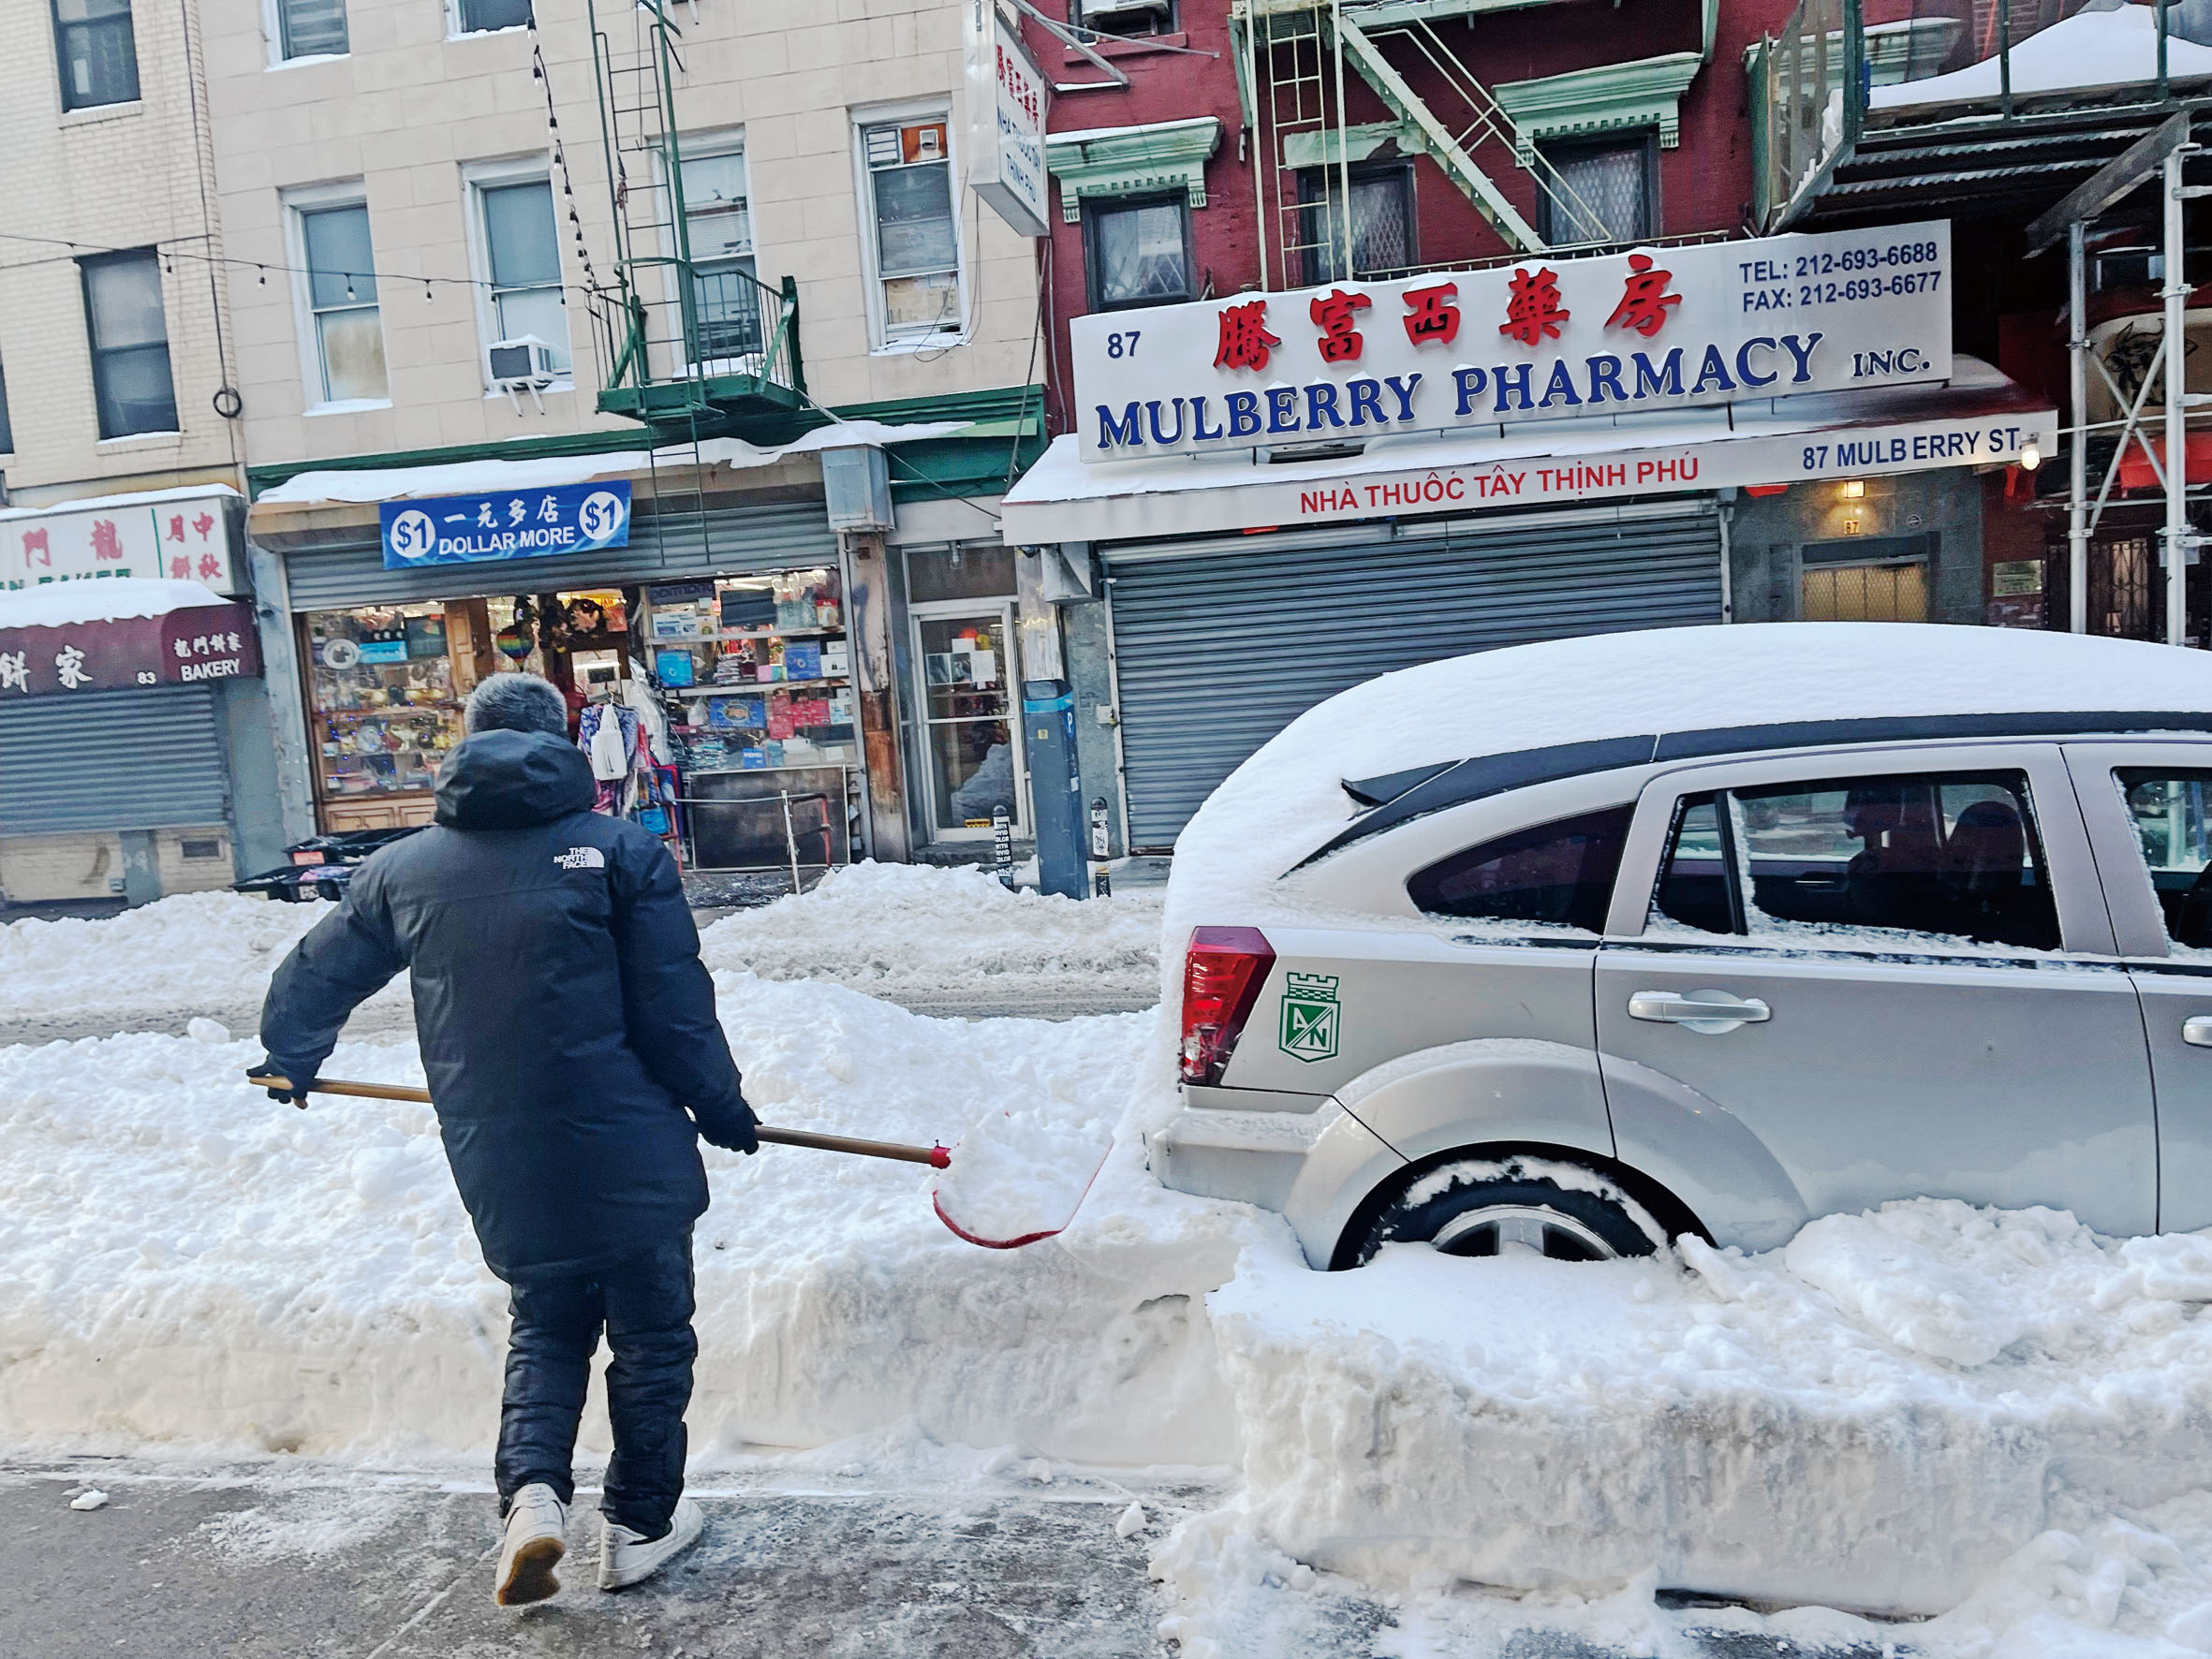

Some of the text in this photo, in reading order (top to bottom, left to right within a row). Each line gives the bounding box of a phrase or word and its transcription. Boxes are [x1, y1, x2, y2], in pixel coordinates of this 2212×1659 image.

[1739, 242, 1938, 284] TEL: 212-693-6688
[1743, 271, 1941, 313] FAX: 212-693-6677
[1108, 331, 1141, 359] 87
[1096, 332, 1931, 449] MULBERRY PHARMACY INC.
[1803, 446, 1829, 470] 87
[1836, 431, 1981, 467] MULBERRY
[1300, 451, 1699, 514] NHÀ THUỐC TÂY THỊNH PHÚ
[444, 494, 559, 529] 一元多店
[583, 499, 616, 534] $1
[397, 519, 428, 551] $1
[438, 526, 575, 555] DOLLAR MORE
[137, 671, 156, 684] 83
[181, 658, 240, 682] BAKERY
[553, 854, 586, 863] NORTH
